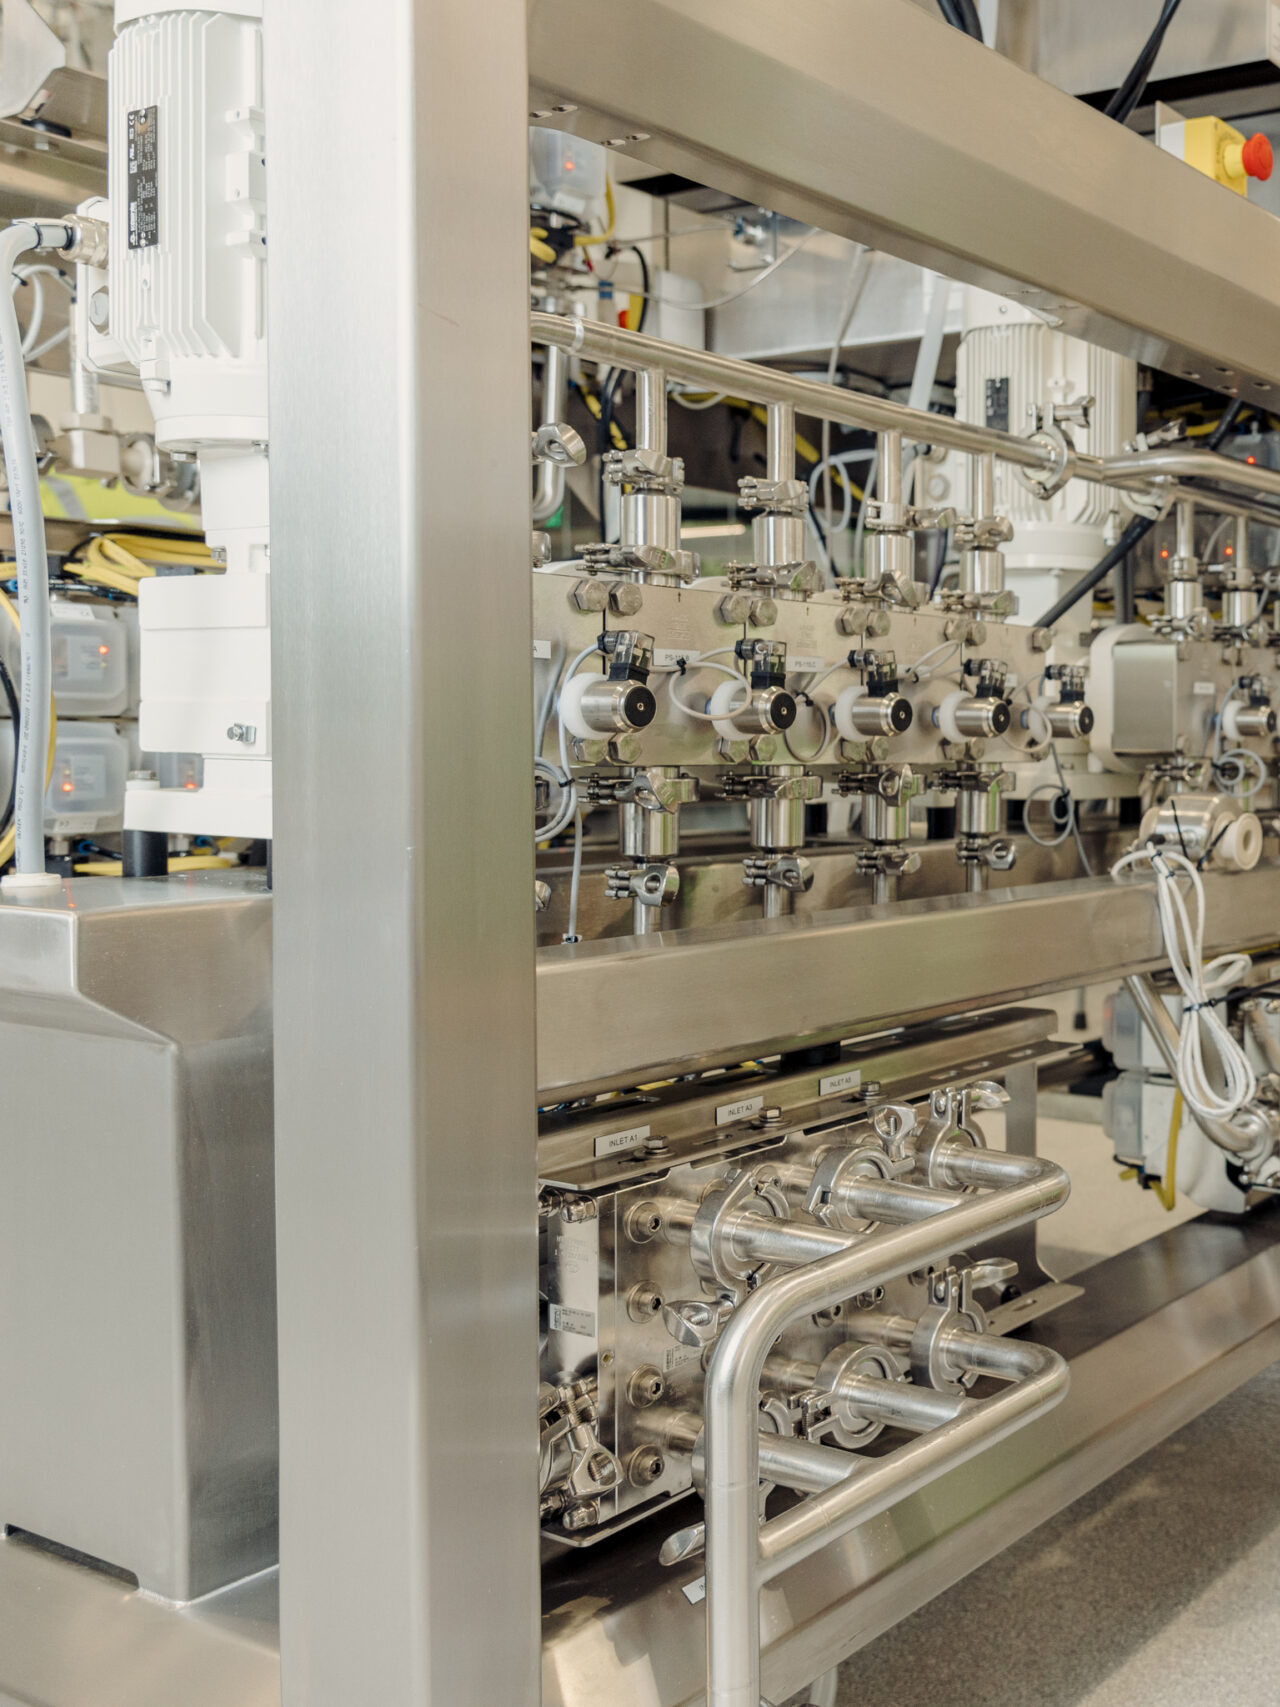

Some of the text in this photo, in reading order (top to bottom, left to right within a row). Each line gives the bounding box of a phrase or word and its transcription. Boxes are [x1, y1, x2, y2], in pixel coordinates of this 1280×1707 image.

[728, 1105, 745, 1117] INLET
[608, 1134, 638, 1148] INLET A1
